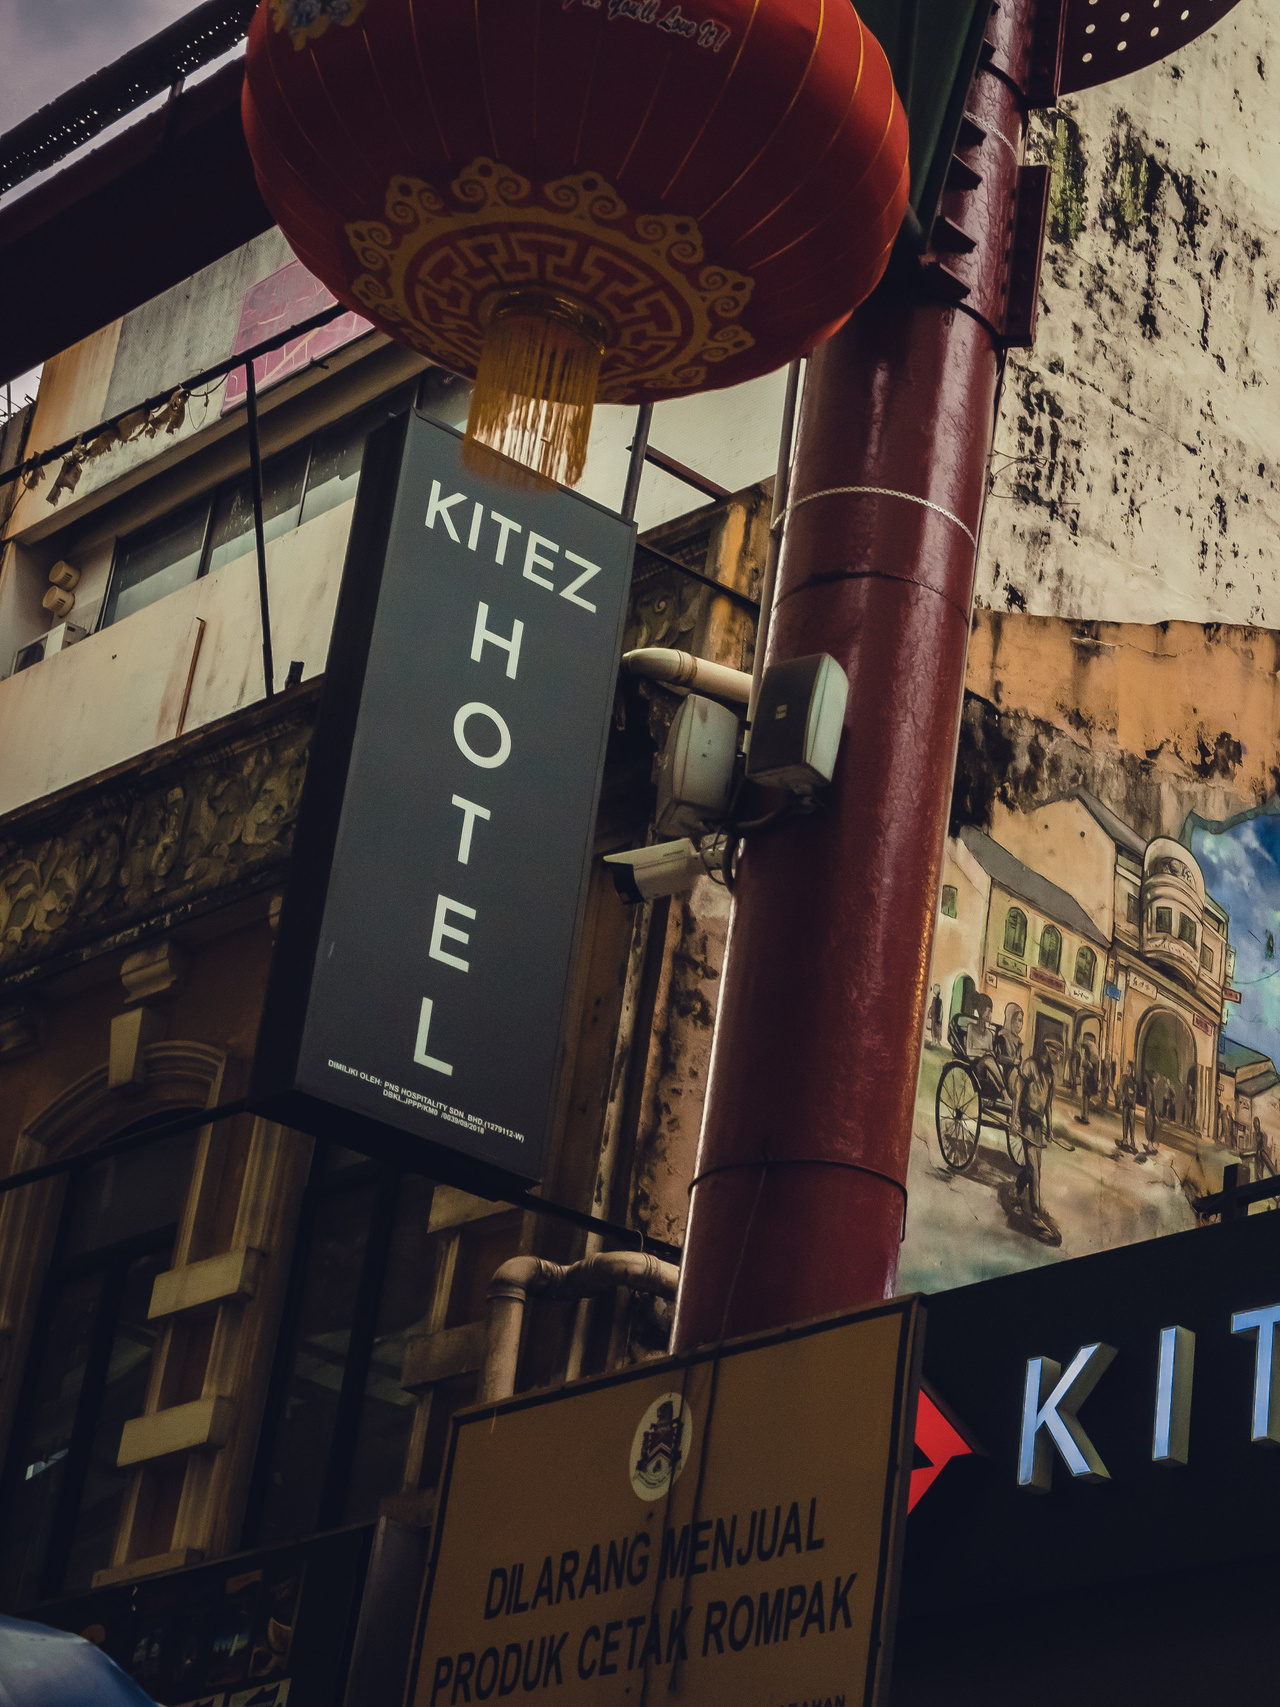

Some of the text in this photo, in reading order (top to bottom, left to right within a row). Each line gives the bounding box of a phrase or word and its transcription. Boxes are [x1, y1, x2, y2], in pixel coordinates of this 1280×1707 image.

[656, 5, 697, 37] Love
[425, 479, 602, 623] KITEZ
[413, 600, 524, 1076] HOTEL
[328, 1060, 358, 1077] DIMILIKI
[360, 1072, 382, 1086] OLEH:
[384, 1081, 399, 1093] PNS
[401, 1088, 448, 1111] HOSPITALITY
[449, 1106, 465, 1119] SDN.
[484, 1497, 826, 1620] DILARANG MENJUAL
[430, 1572, 858, 1707] PRODUK CETAK ROMPAK
